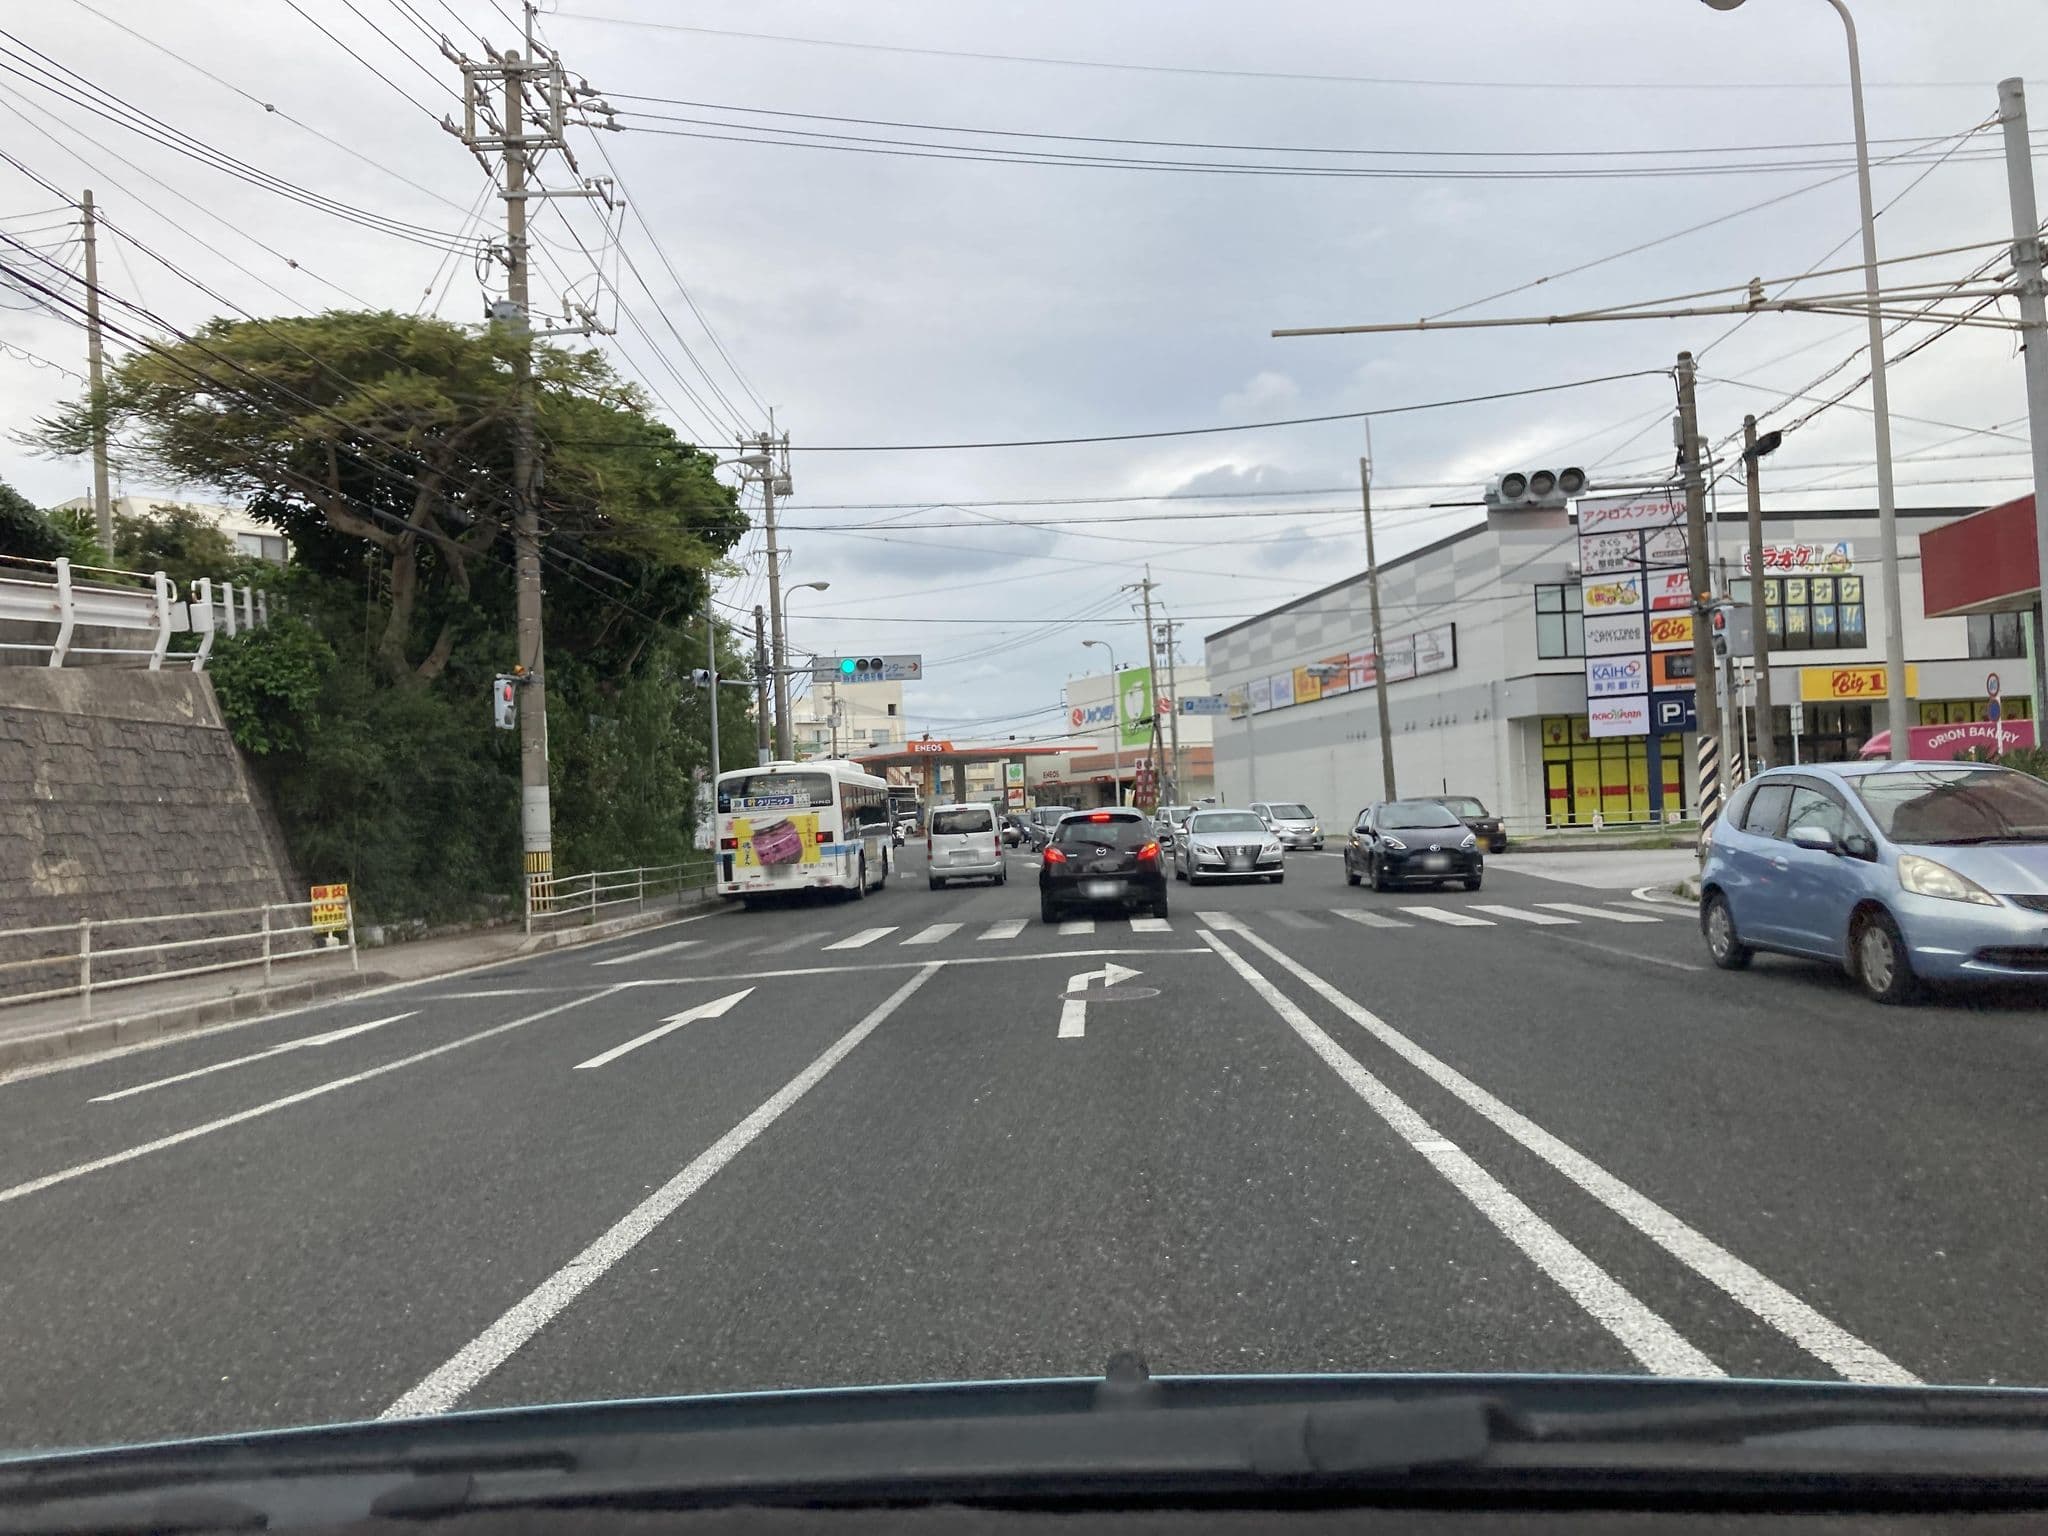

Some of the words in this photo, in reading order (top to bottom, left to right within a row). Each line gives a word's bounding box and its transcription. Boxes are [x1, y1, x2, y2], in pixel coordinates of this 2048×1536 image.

[1651, 620, 1687, 640] Big
[1592, 666, 1635, 680] KAIHO
[1832, 672, 1864, 694] Big
[1869, 673, 1887, 691] 1
[1928, 728, 1966, 749] ORION
[915, 744, 943, 752] ENEOS
[1042, 771, 1060, 779] ENEOS
